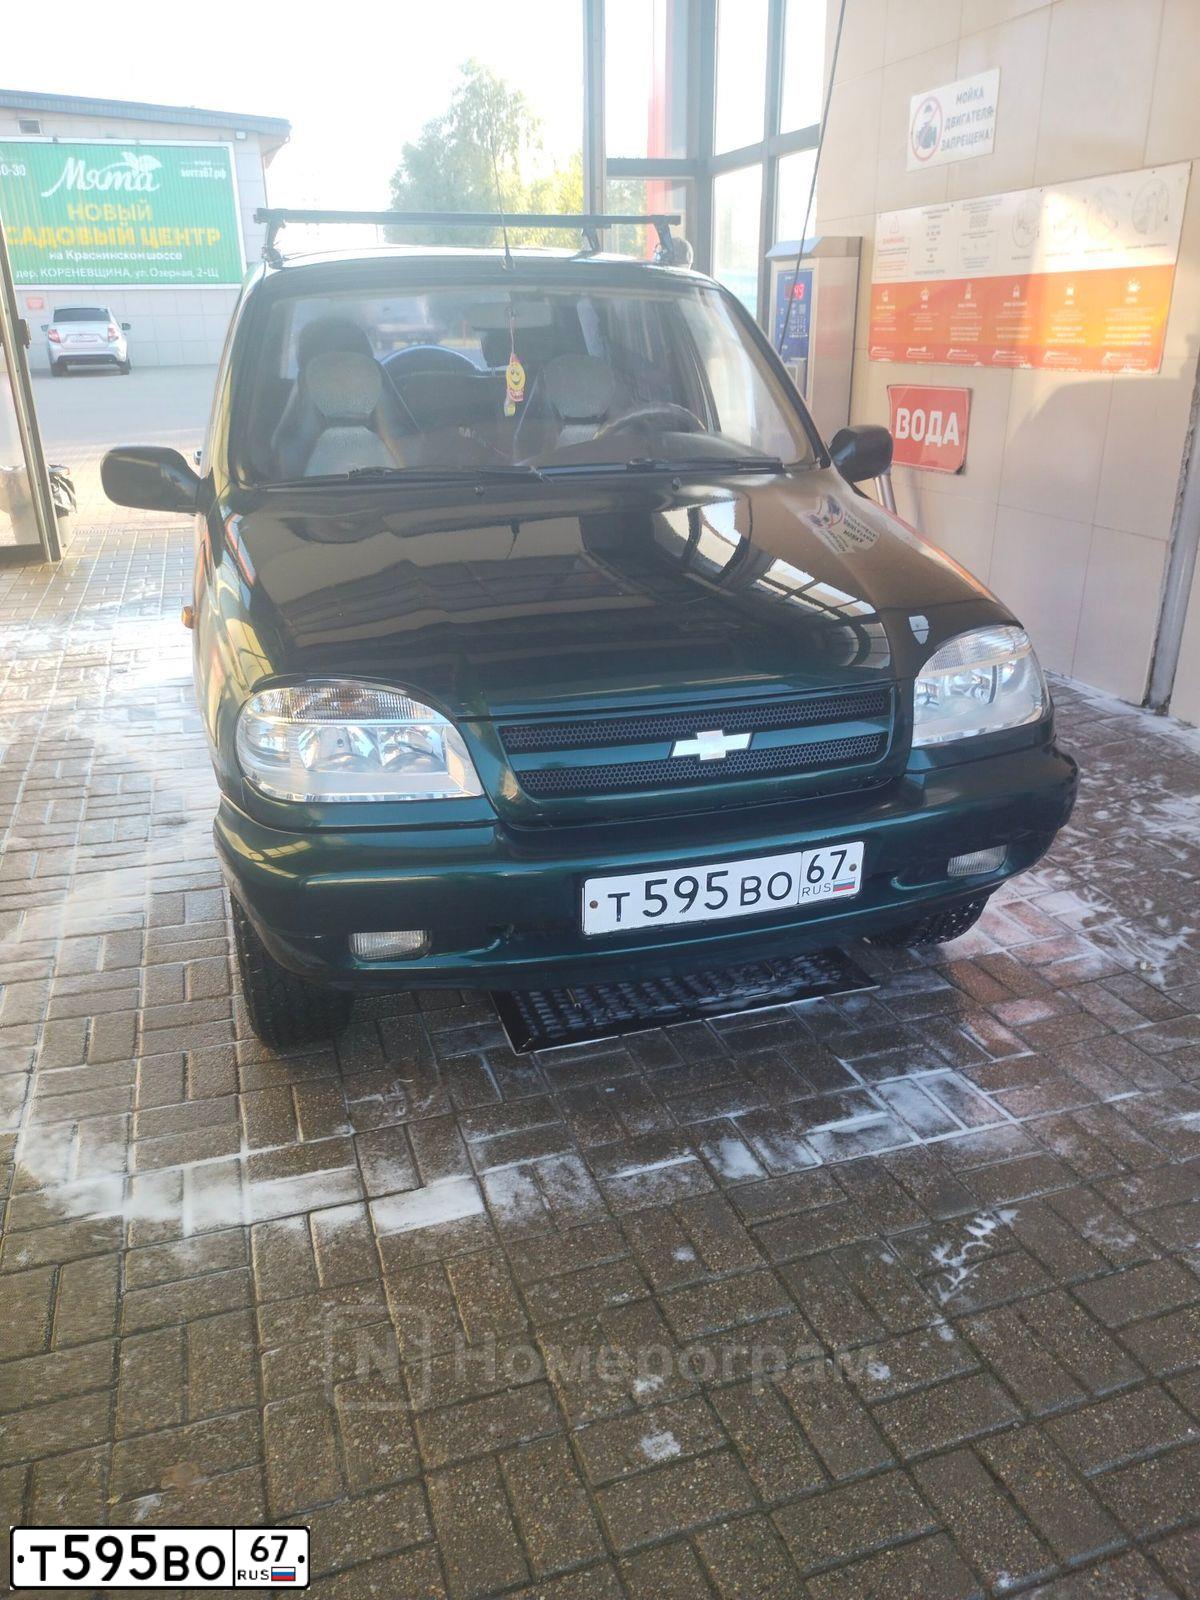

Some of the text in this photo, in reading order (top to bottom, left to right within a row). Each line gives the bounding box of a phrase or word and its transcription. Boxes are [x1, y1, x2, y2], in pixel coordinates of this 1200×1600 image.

[956, 86, 984, 104] МОЙКА
[945, 105, 994, 131] ДВИГАТЕЛЯ
[41, 151, 163, 197] Мята
[67, 198, 153, 222] НОВЫЙ
[6, 221, 221, 249] САДОВЫЙ ЦЕНТР
[147, 252, 183, 261] шоссе
[895, 407, 960, 448] ВОДА
[806, 849, 848, 884] 67
[802, 882, 832, 898] RUS
